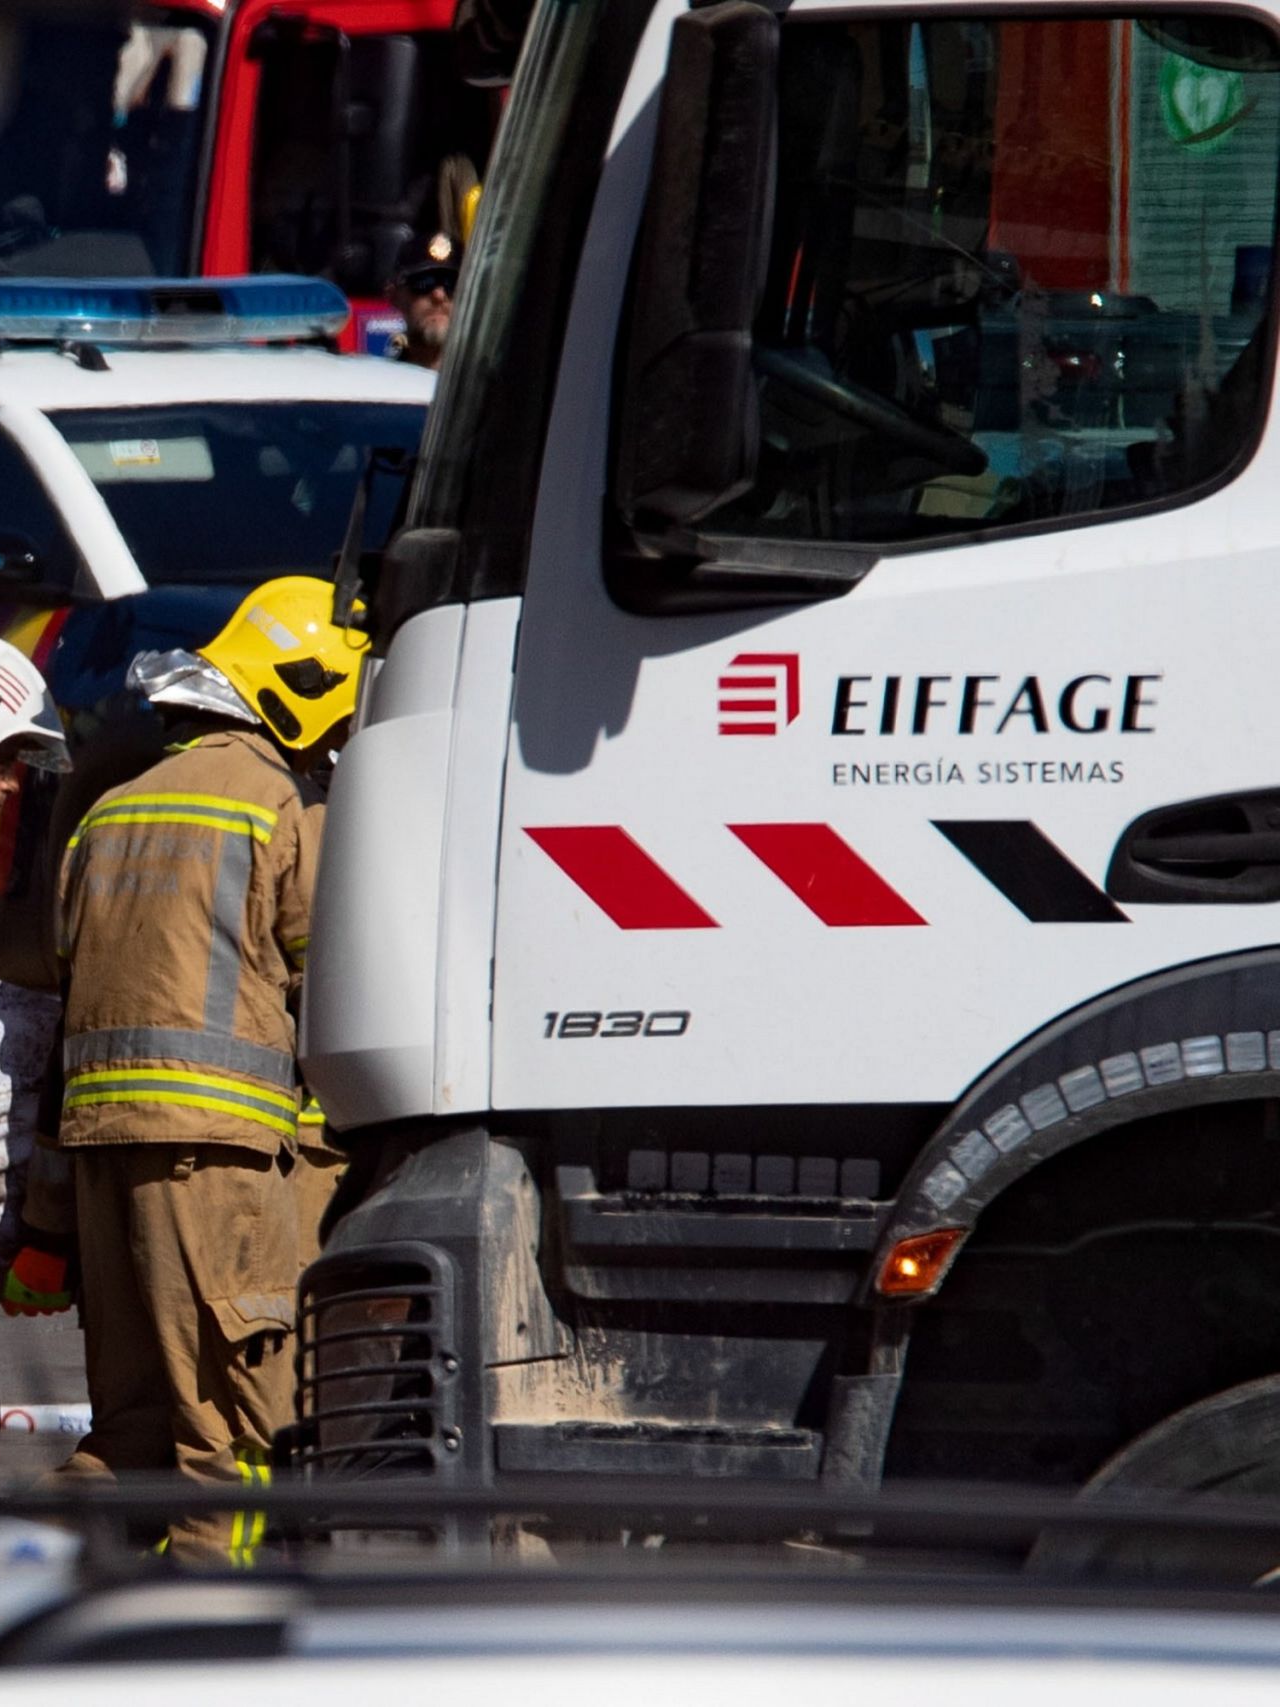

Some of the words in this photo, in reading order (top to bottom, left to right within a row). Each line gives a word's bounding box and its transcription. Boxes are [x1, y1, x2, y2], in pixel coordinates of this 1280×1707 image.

[830, 674, 1162, 735] EIFFAGE
[832, 757, 964, 786] ENERGÍA
[978, 761, 1124, 784] SISTEMAS
[544, 1010, 691, 1039] 1830
